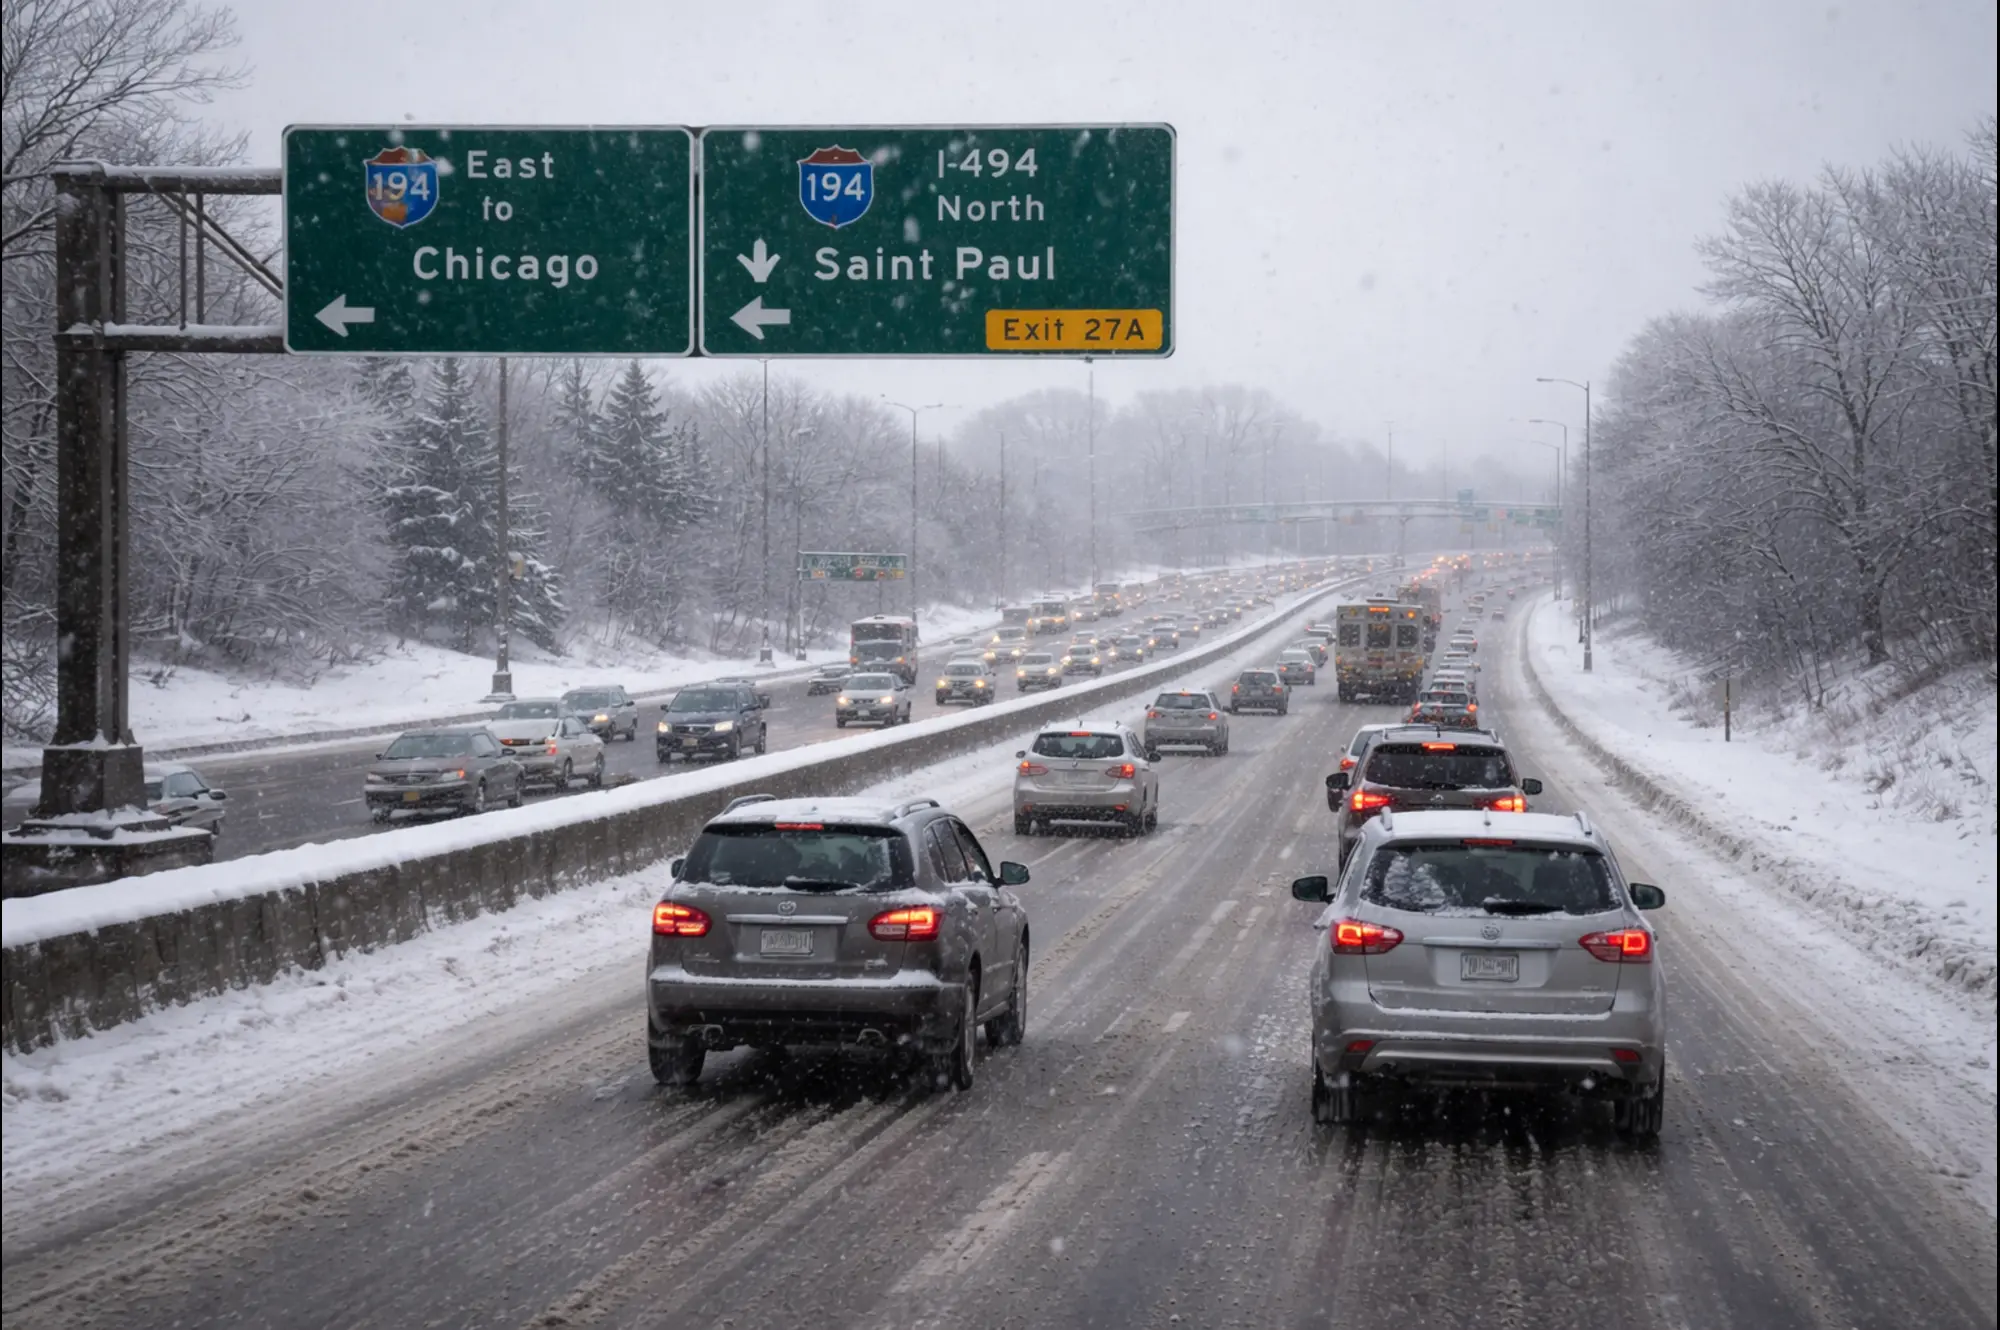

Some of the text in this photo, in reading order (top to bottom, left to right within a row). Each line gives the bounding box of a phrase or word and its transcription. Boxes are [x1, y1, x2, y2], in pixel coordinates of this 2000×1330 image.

[467, 150, 555, 179] East
[937, 147, 1039, 178] I-494
[373, 171, 431, 201] 194
[806, 172, 866, 202] 194
[482, 196, 513, 221] to
[937, 194, 1045, 222] North
[413, 246, 598, 288] Chicago
[814, 246, 1055, 280] Saint Paul
[1003, 317, 1145, 342] Exit 27A
